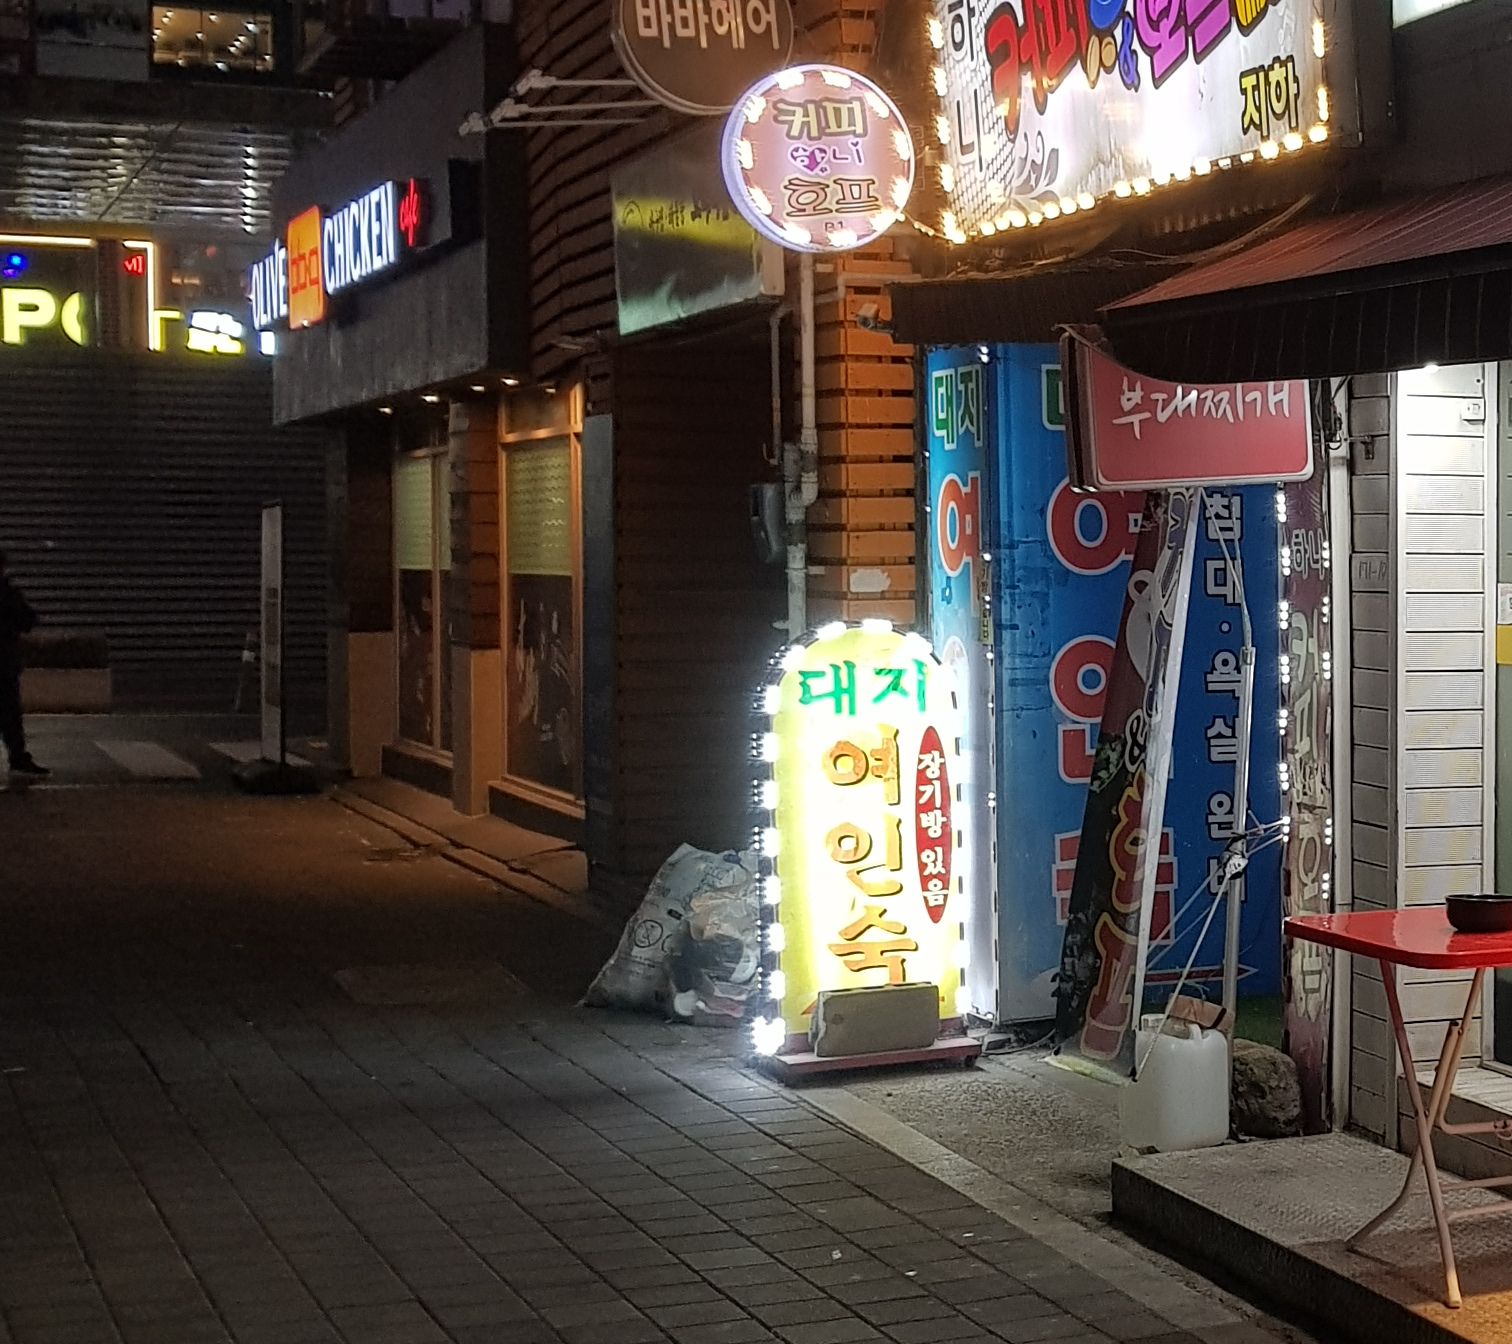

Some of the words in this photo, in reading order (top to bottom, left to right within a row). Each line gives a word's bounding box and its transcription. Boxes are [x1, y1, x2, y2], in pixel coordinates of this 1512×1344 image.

[1117, 14, 1141, 92] &
[773, 96, 869, 142] 커피
[1240, 55, 1300, 138] 지하
[789, 139, 866, 174] 하니
[782, 175, 884, 219] 호프
[251, 238, 289, 332] OLIVE
[323, 181, 397, 296] CHICKEN
[932, 363, 984, 451] 대지
[1112, 376, 1290, 440] 부대찌개
[1291, 528, 1325, 581] 하니
[798, 659, 929, 717] 대지
[917, 750, 946, 839] 장기방
[821, 722, 920, 988] 여인숙
[920, 846, 951, 909] 있음
